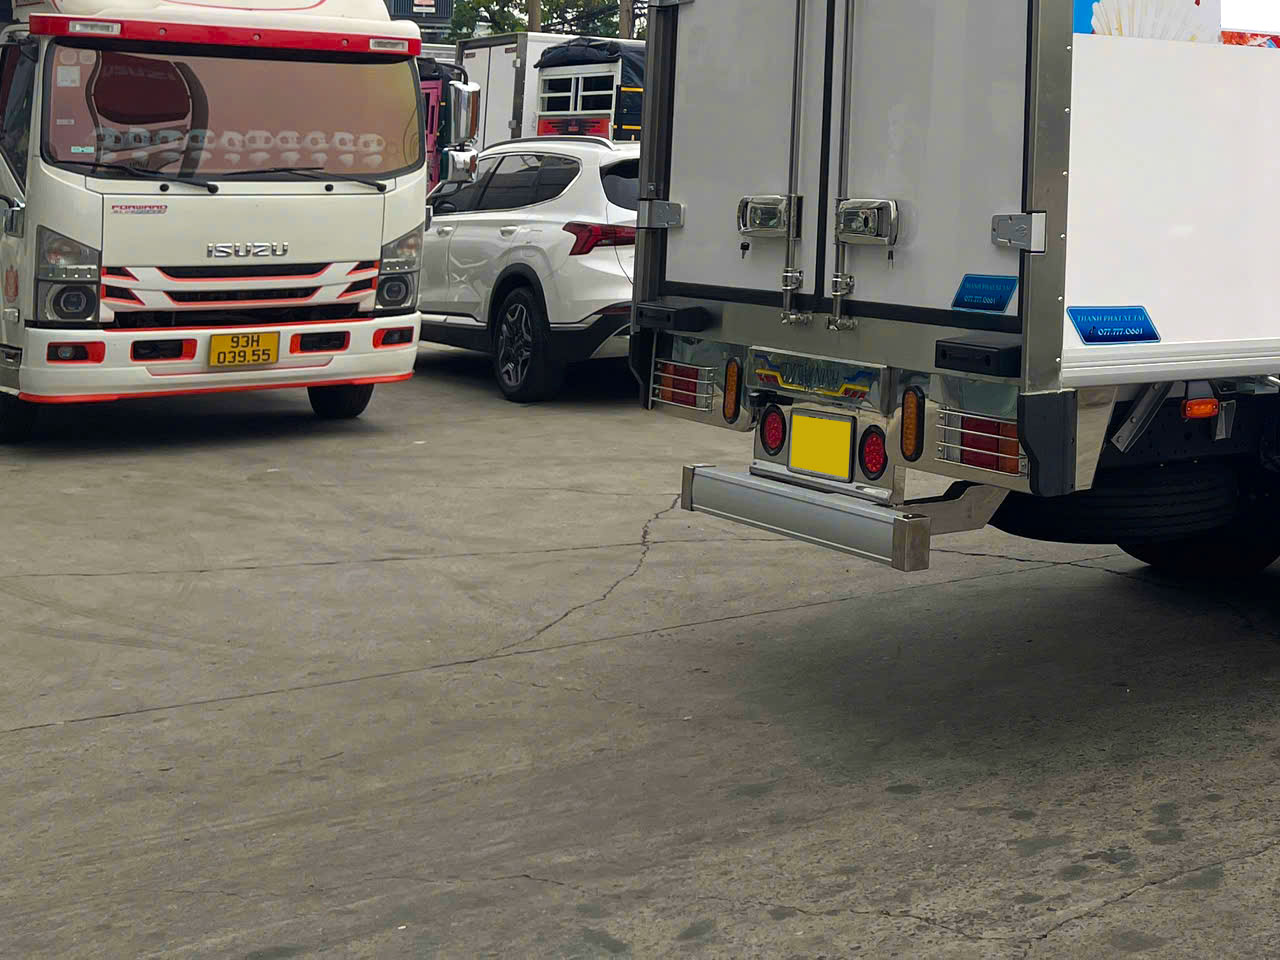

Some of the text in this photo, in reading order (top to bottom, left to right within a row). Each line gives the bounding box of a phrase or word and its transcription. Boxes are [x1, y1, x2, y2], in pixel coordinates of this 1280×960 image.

[206, 242, 289, 258] ISUZU
[231, 334, 260, 349] 93H
[217, 348, 271, 365] 039.55
